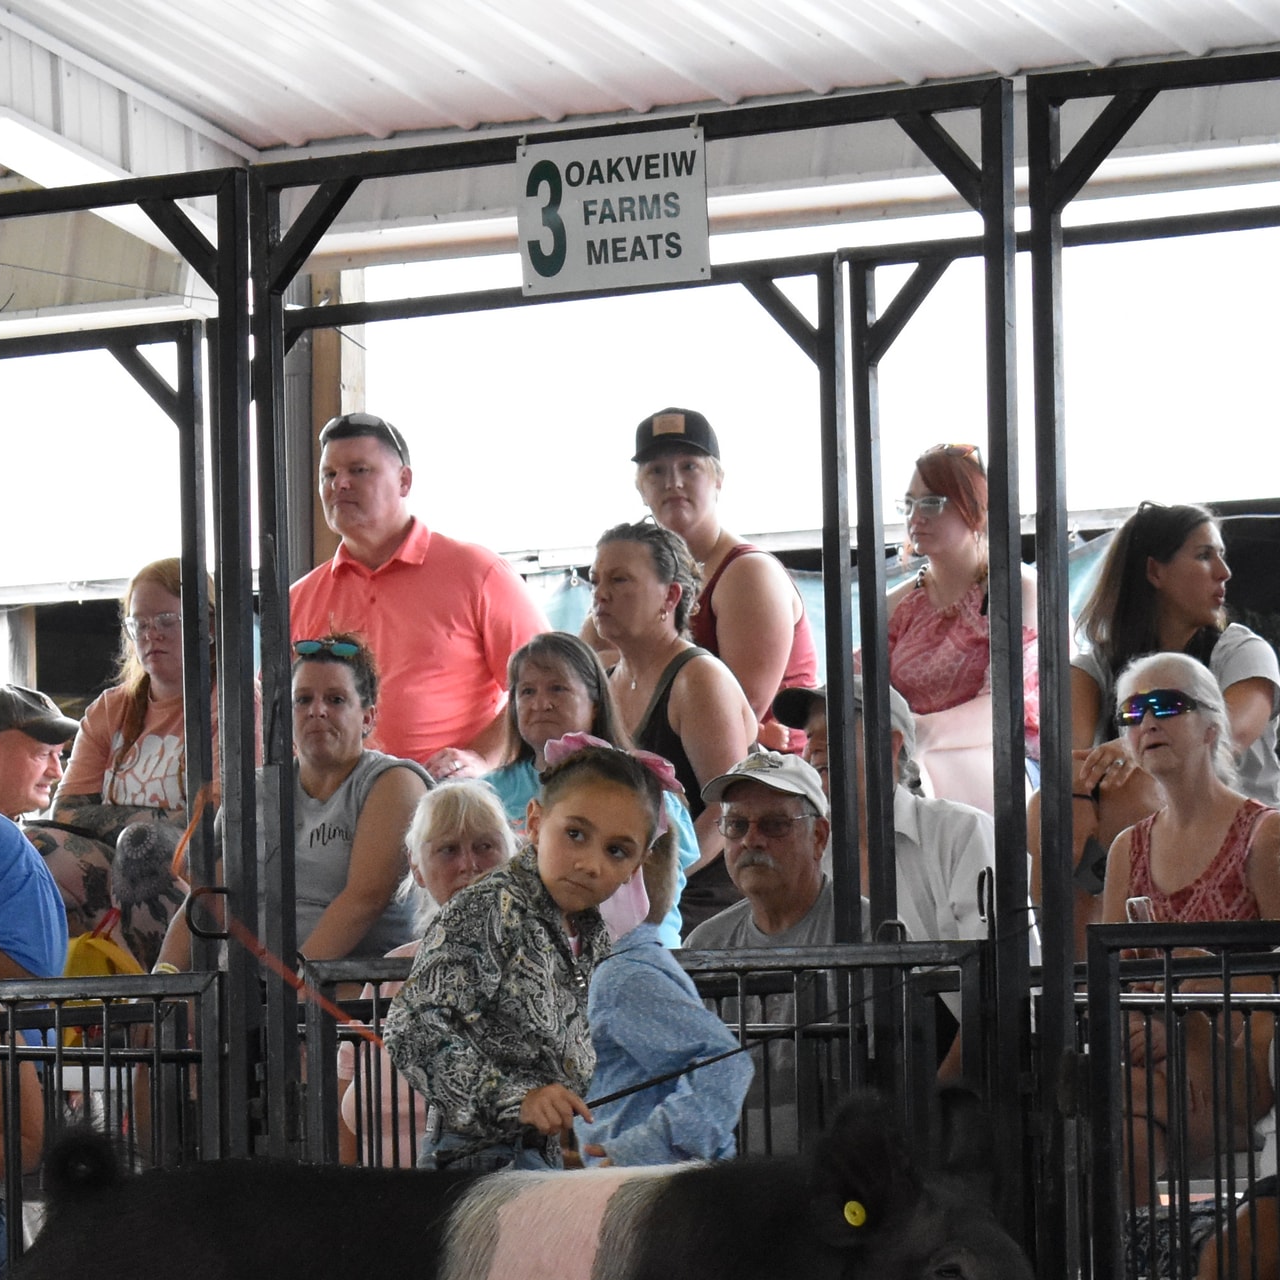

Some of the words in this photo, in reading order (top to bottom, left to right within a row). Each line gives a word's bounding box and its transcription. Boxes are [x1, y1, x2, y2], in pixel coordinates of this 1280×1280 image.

[565, 150, 697, 187] OAKVEIW
[525, 159, 567, 277] 3
[583, 191, 680, 225] FARMS
[586, 231, 682, 265] MEATS
